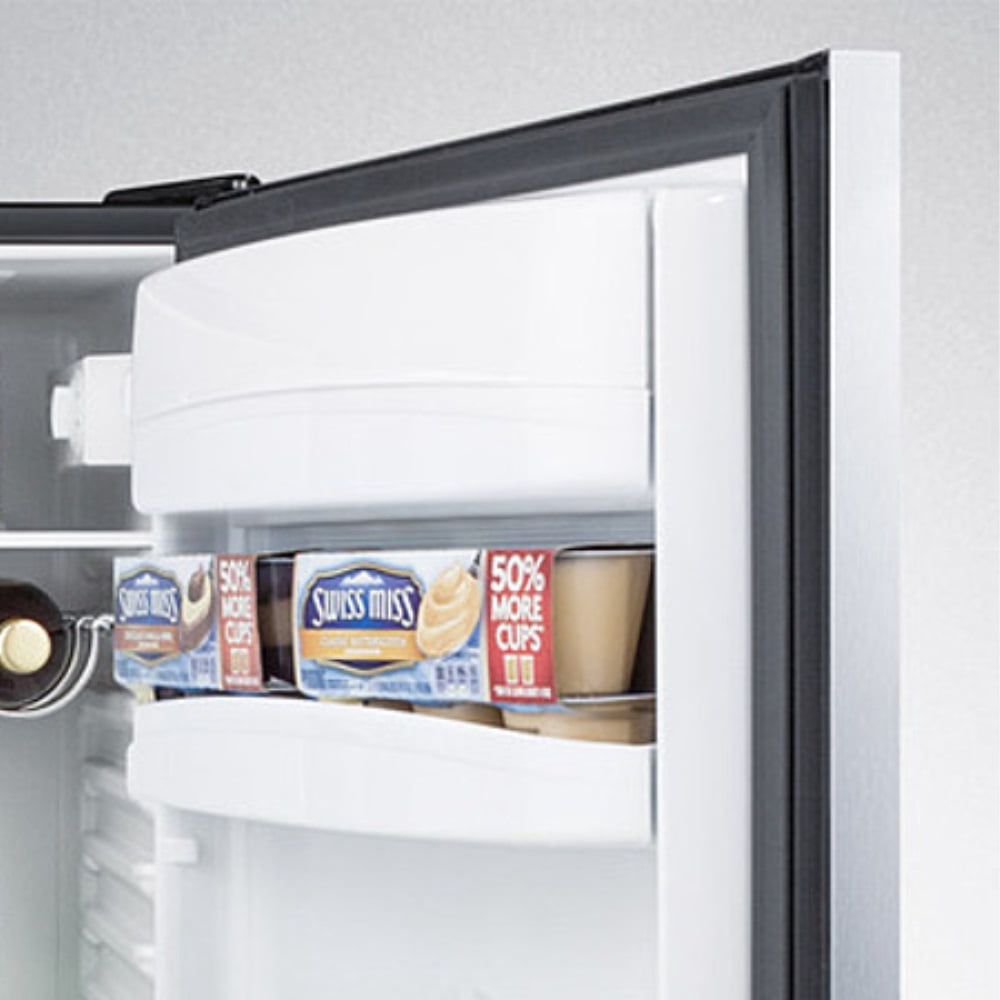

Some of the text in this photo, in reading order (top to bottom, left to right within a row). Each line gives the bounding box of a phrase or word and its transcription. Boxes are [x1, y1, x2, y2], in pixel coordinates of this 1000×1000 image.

[491, 553, 546, 593] 50%
[312, 585, 415, 629] SWISS MISS
[490, 594, 543, 622] MORE
